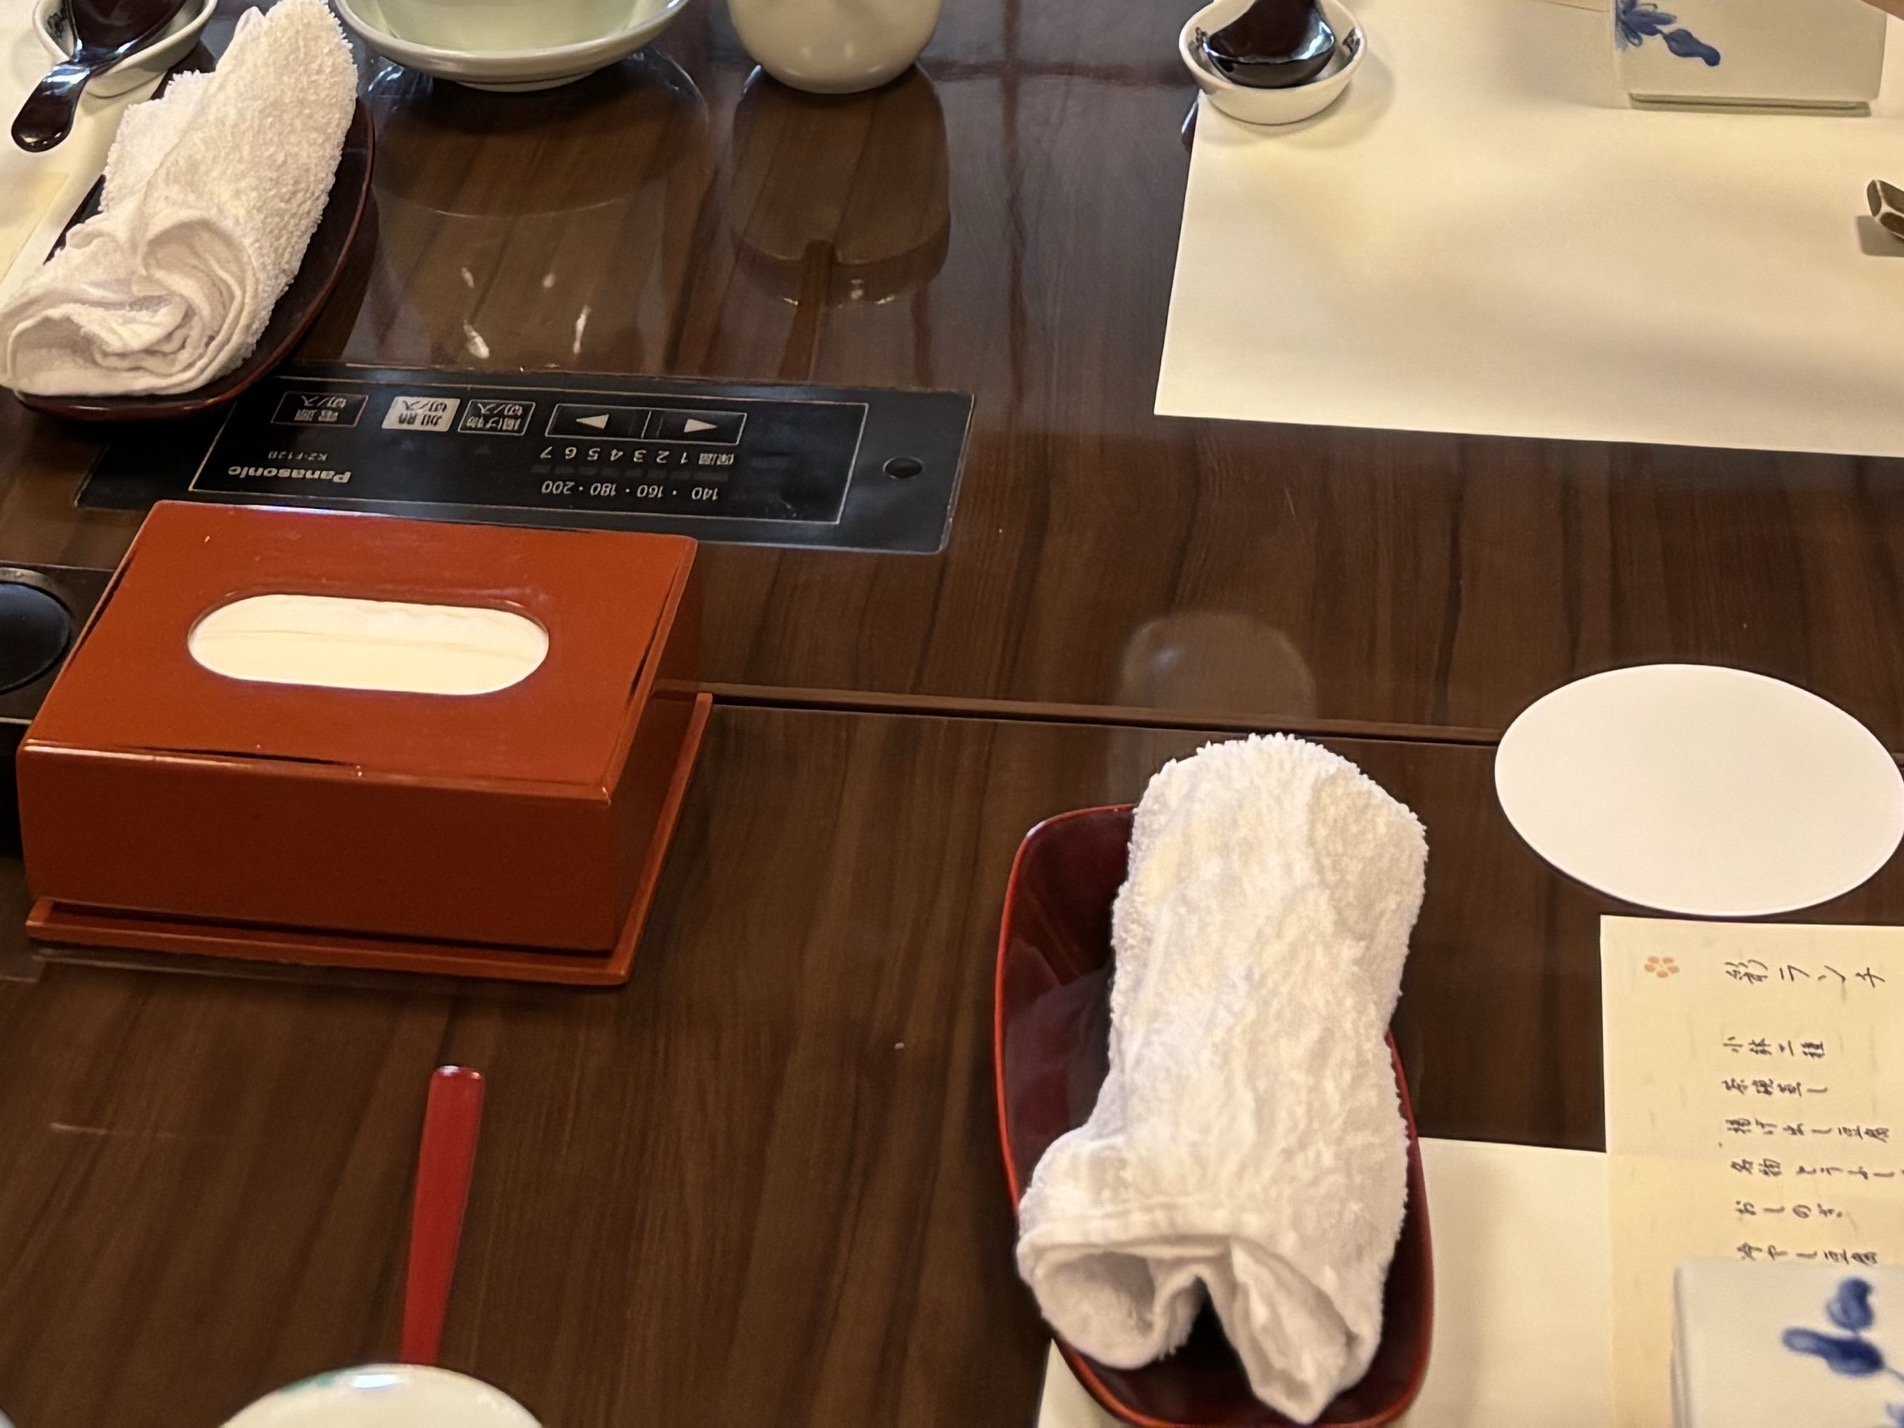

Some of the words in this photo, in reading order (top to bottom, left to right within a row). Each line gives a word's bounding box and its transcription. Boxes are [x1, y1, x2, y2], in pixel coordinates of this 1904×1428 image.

[293, 408, 339, 422] 電源
[398, 413, 442, 426] 加熱
[539, 445, 553, 459] 7
[564, 446, 577, 460] 6
[586, 447, 601, 461] 5
[610, 448, 624, 462] 4
[633, 449, 647, 463] 3
[656, 450, 670, 464] 2
[680, 451, 688, 464] 1
[227, 465, 352, 484] Panasonic
[541, 480, 576, 495] 200
[589, 482, 617, 497] 180
[636, 484, 664, 499] 160
[691, 486, 718, 501] 140
[1724, 958, 1886, 989] 彩ランチ
[1722, 1035, 1826, 1059] 小鉢二種
[1721, 1077, 1829, 1098] 茶碗蒸し
[1725, 1117, 1890, 1144] 揚げ出し豆腐
[1730, 1158, 1783, 1178] 名物
[1734, 1200, 1843, 1220] おしのぎ
